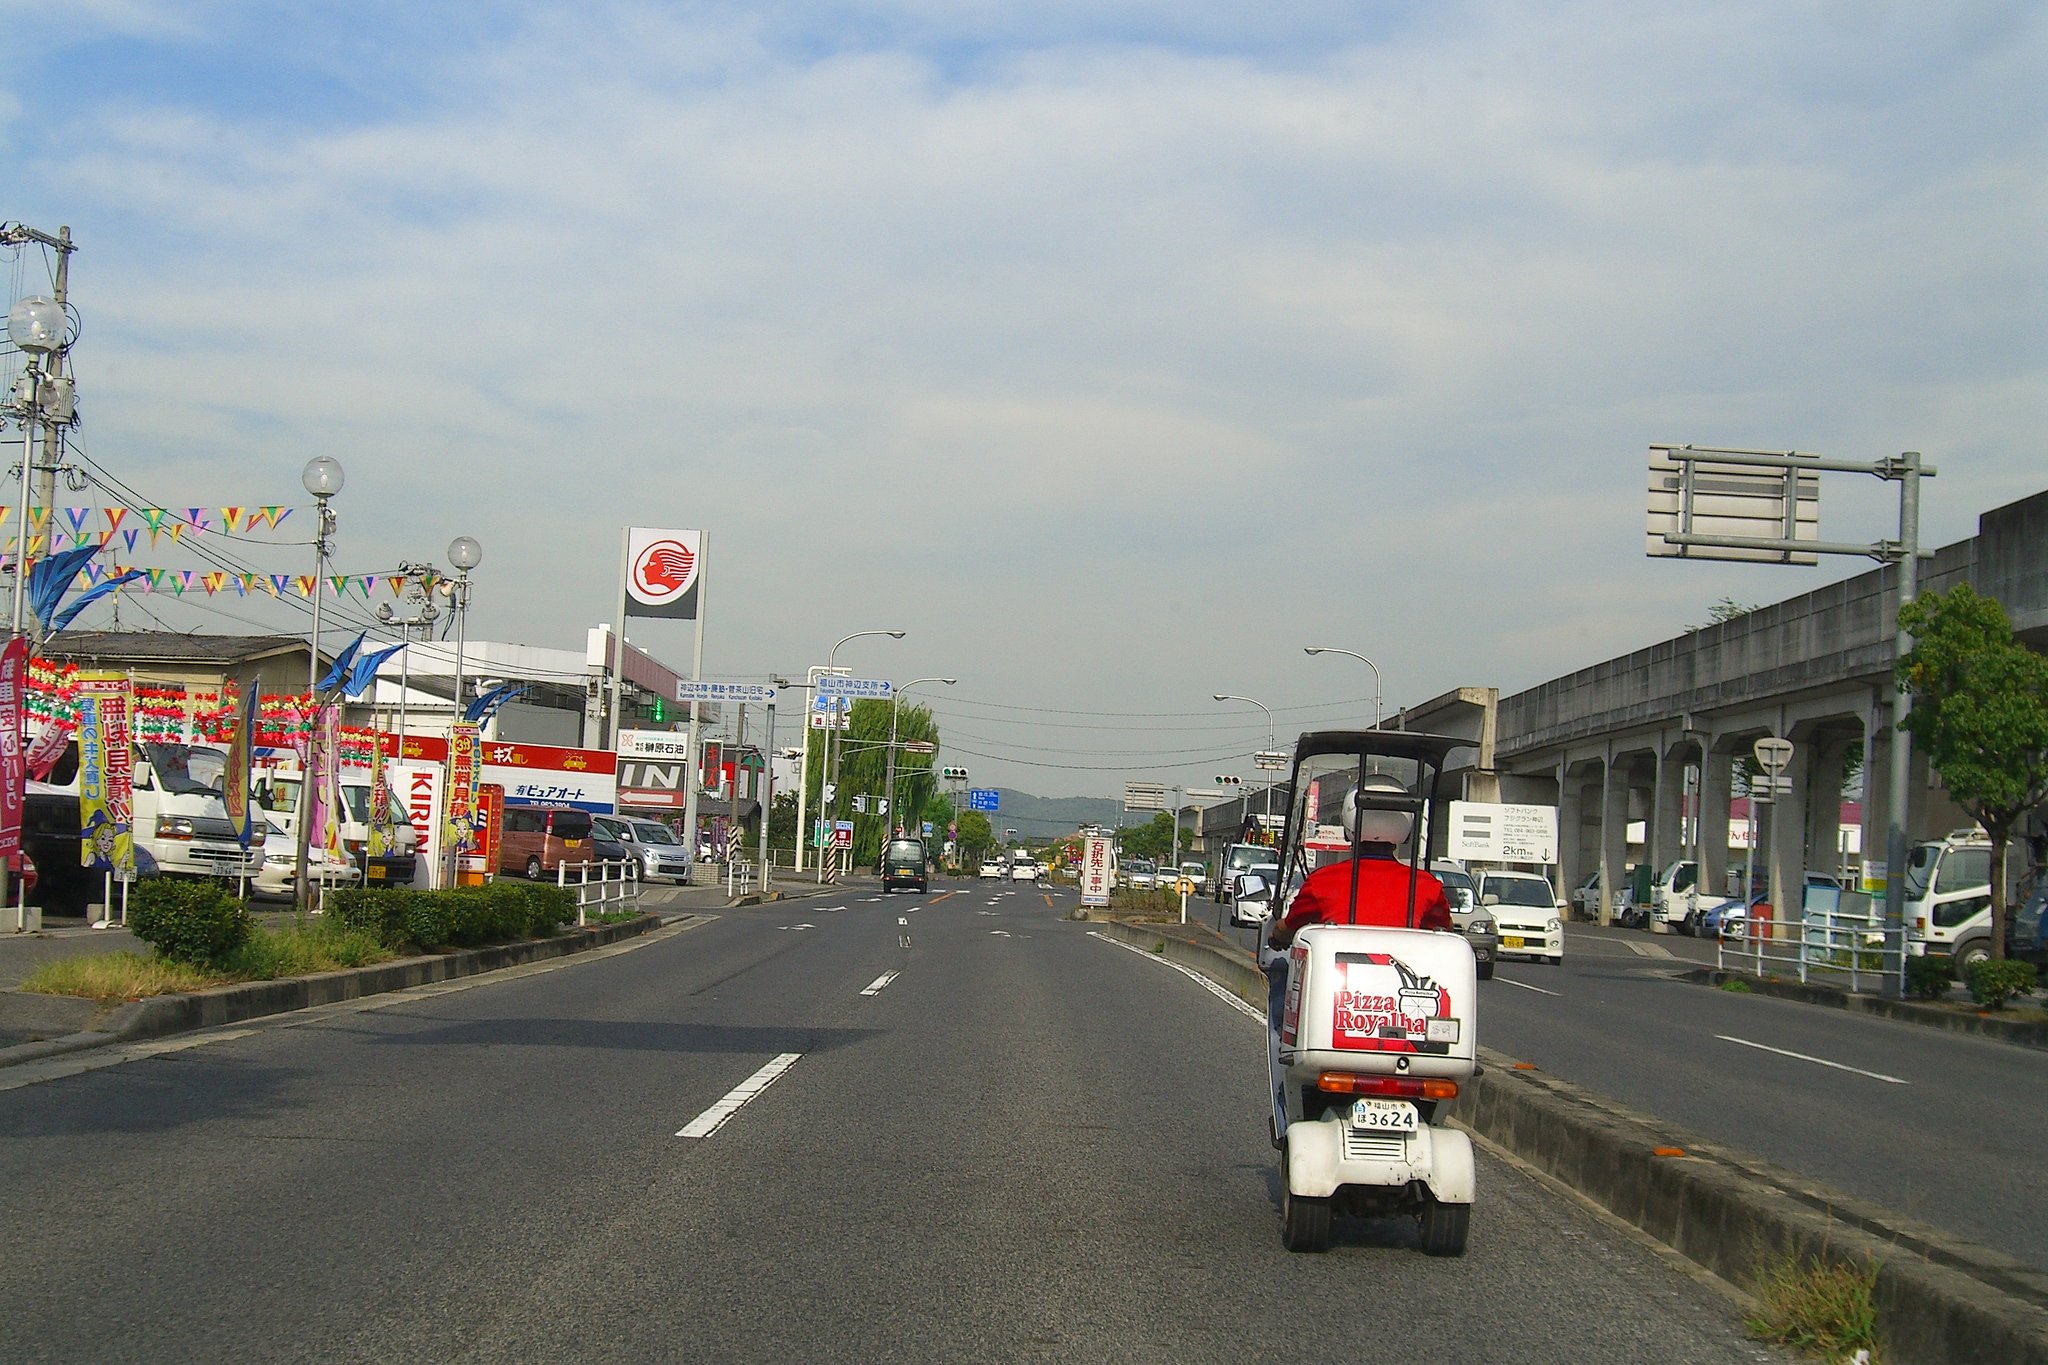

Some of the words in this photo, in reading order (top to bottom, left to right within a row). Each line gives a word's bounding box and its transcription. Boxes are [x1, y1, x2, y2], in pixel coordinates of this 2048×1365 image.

[621, 763, 681, 789] IN
[409, 772, 433, 854] KIRIN
[1462, 841, 1490, 849] SoftBank
[1090, 841, 1105, 893] 右折先工事中
[1338, 991, 1397, 1013] Pizza
[1369, 1111, 1413, 1129] 3624
